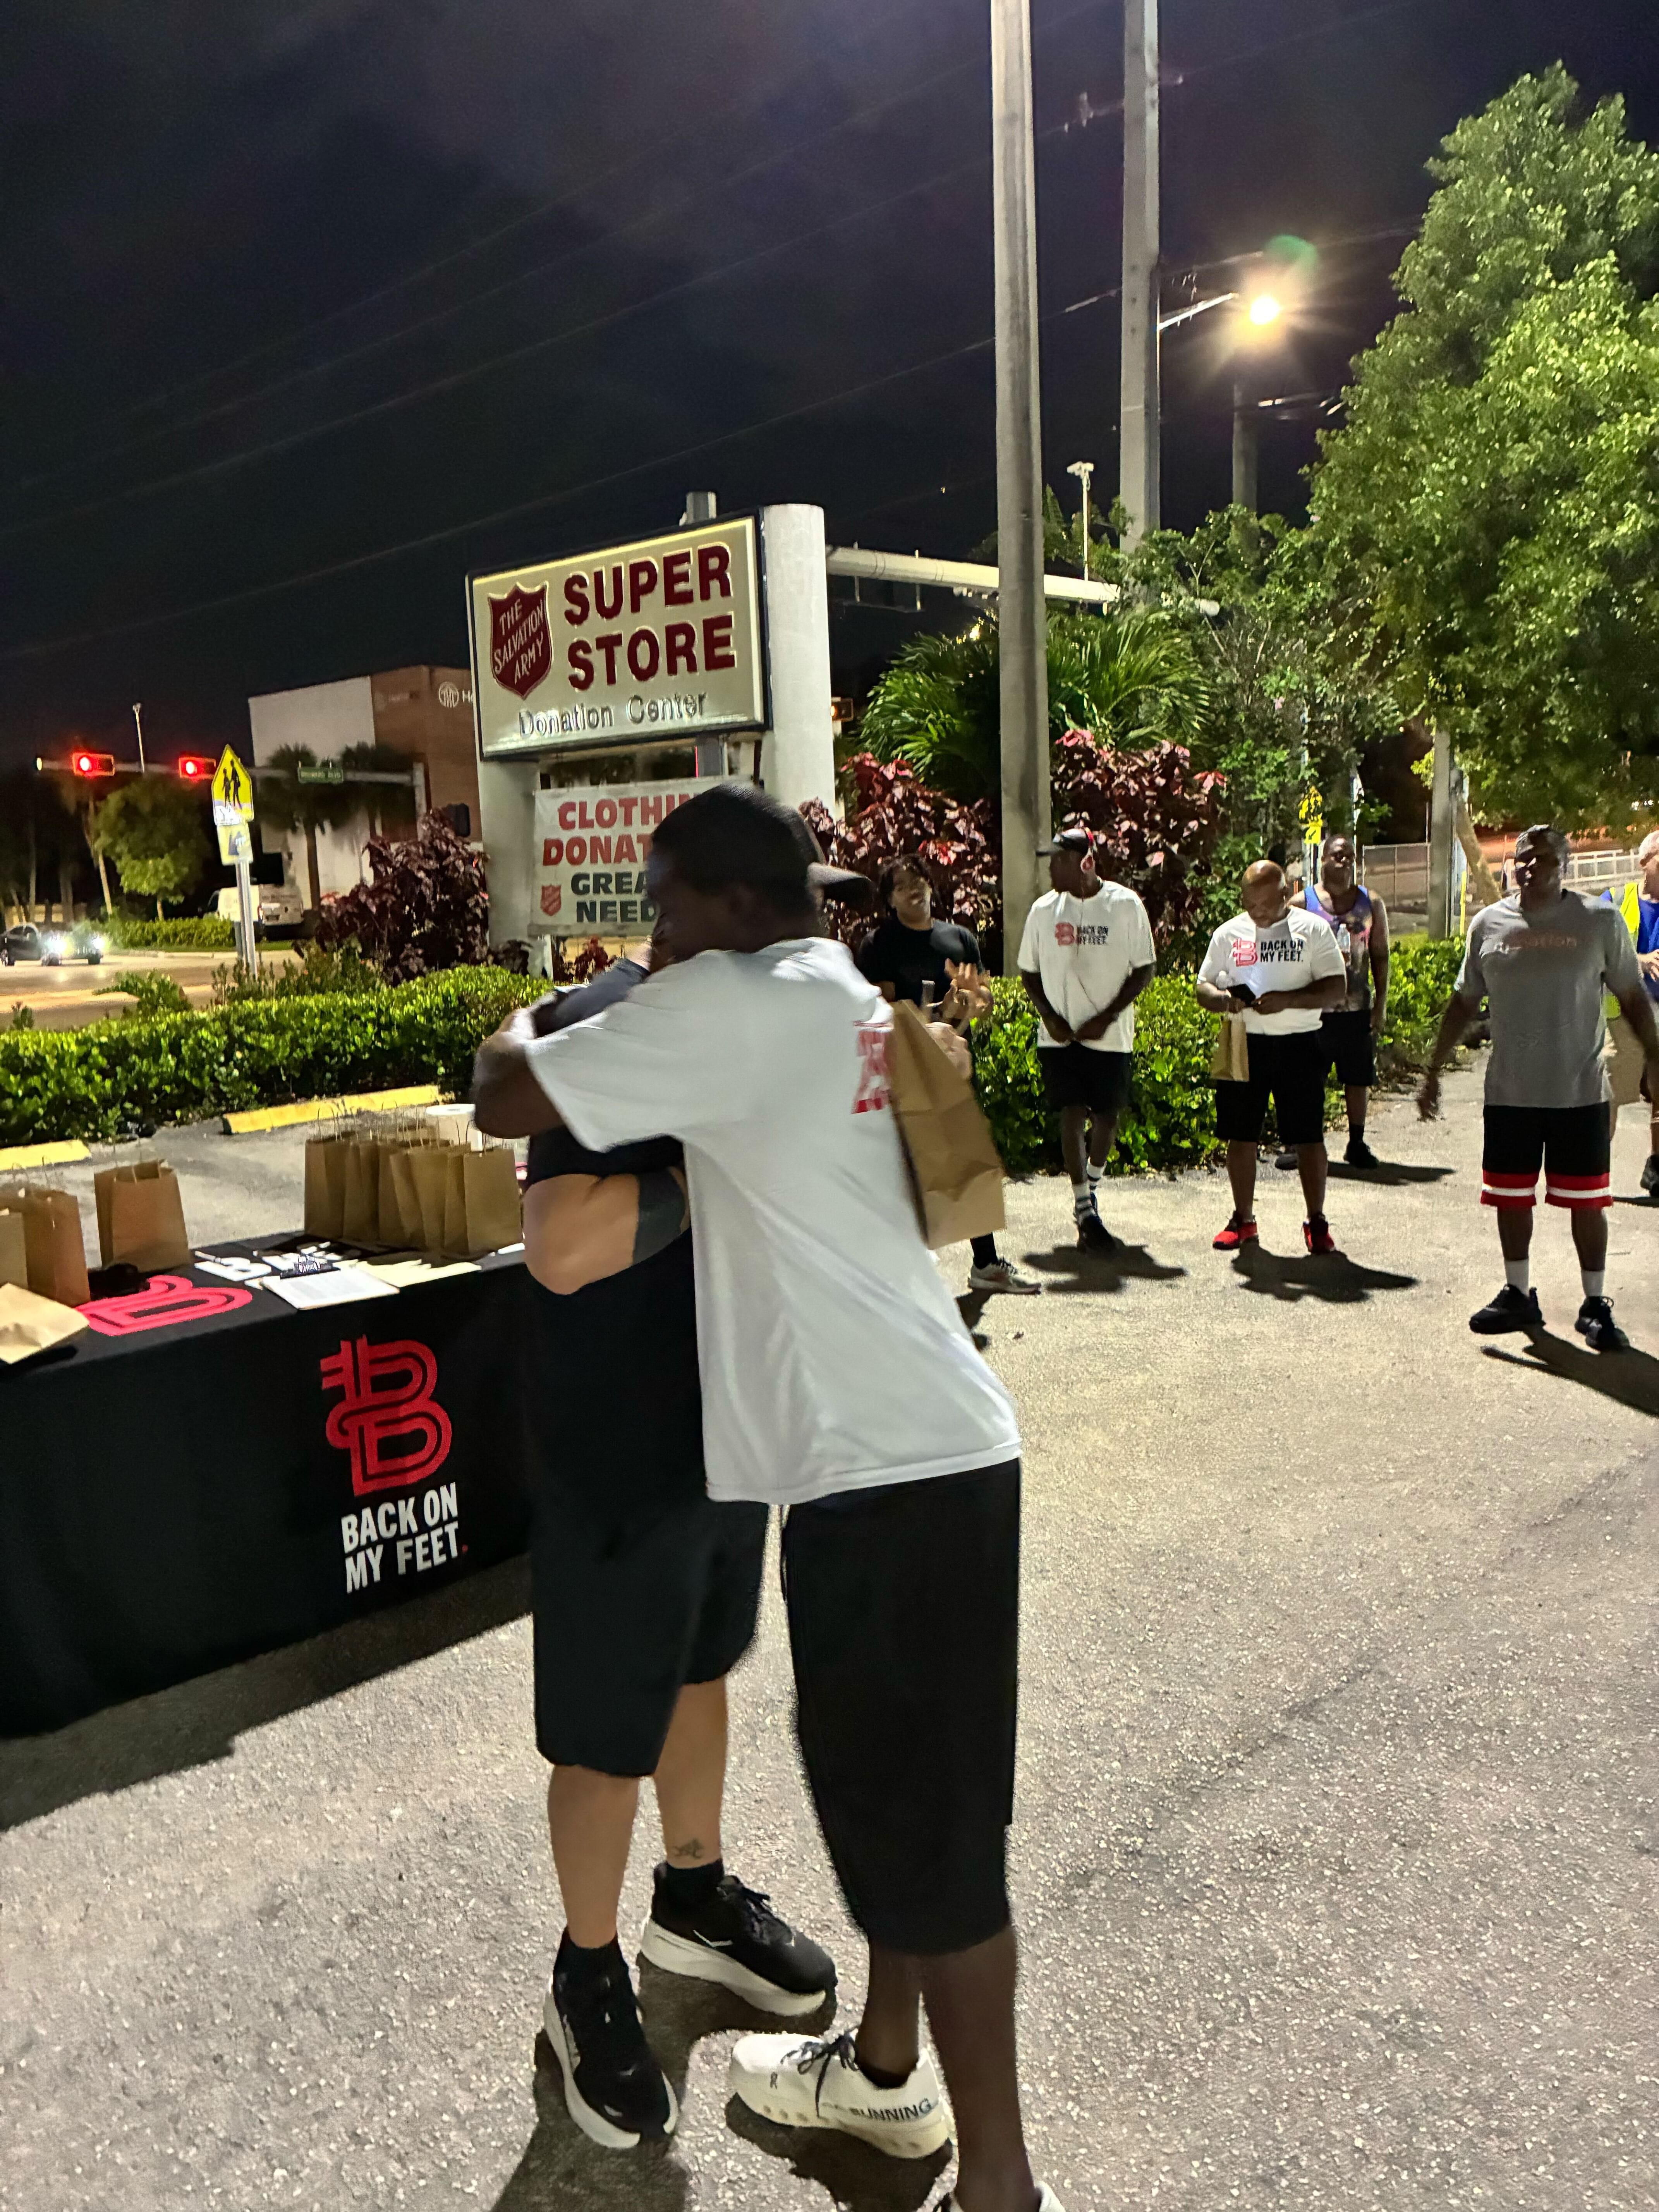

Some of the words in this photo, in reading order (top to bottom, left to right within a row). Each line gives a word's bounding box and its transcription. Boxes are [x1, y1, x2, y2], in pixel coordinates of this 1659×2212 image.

[564, 543, 732, 625] SUPER
[494, 599, 543, 675] SALVATION
[500, 599, 522, 635] THE
[515, 631, 543, 685] ARMY
[568, 614, 735, 690] STORE
[519, 703, 614, 737] Donation
[626, 693, 707, 724] Center
[558, 793, 697, 830] CLOTHI
[576, 900, 656, 922] NEED
[1261, 940, 1286, 951] BACK
[1290, 938, 1304, 950] ON
[1261, 951, 1274, 963] MY
[341, 1496, 417, 1554] BACK
[424, 1482, 458, 1527] ON
[345, 1544, 383, 1594] MY
